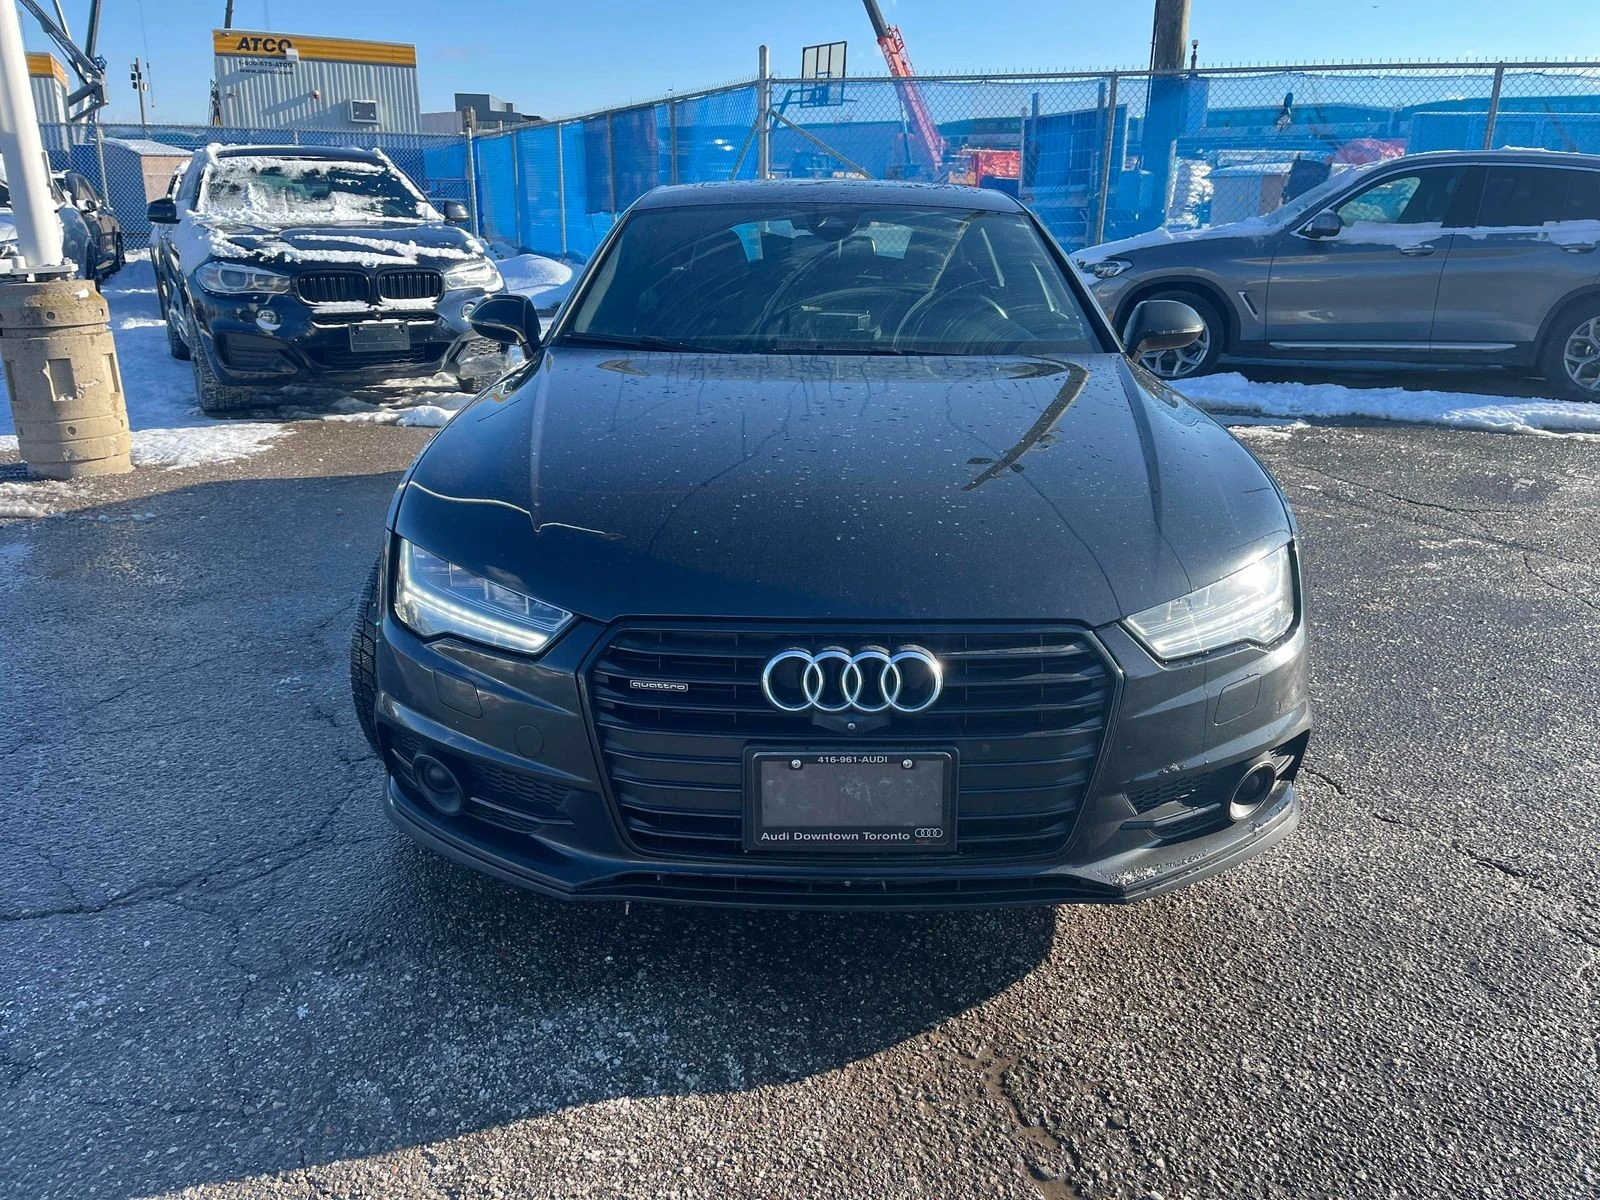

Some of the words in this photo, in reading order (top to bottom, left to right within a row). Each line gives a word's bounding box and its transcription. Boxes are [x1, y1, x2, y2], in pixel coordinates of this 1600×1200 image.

[236, 37, 292, 53] ATCO
[632, 681, 686, 691] quattro
[817, 755, 888, 764] 416-961-AUDI
[761, 831, 790, 841] Audi
[794, 831, 859, 841] Downtown
[862, 831, 911, 841] Toronto
